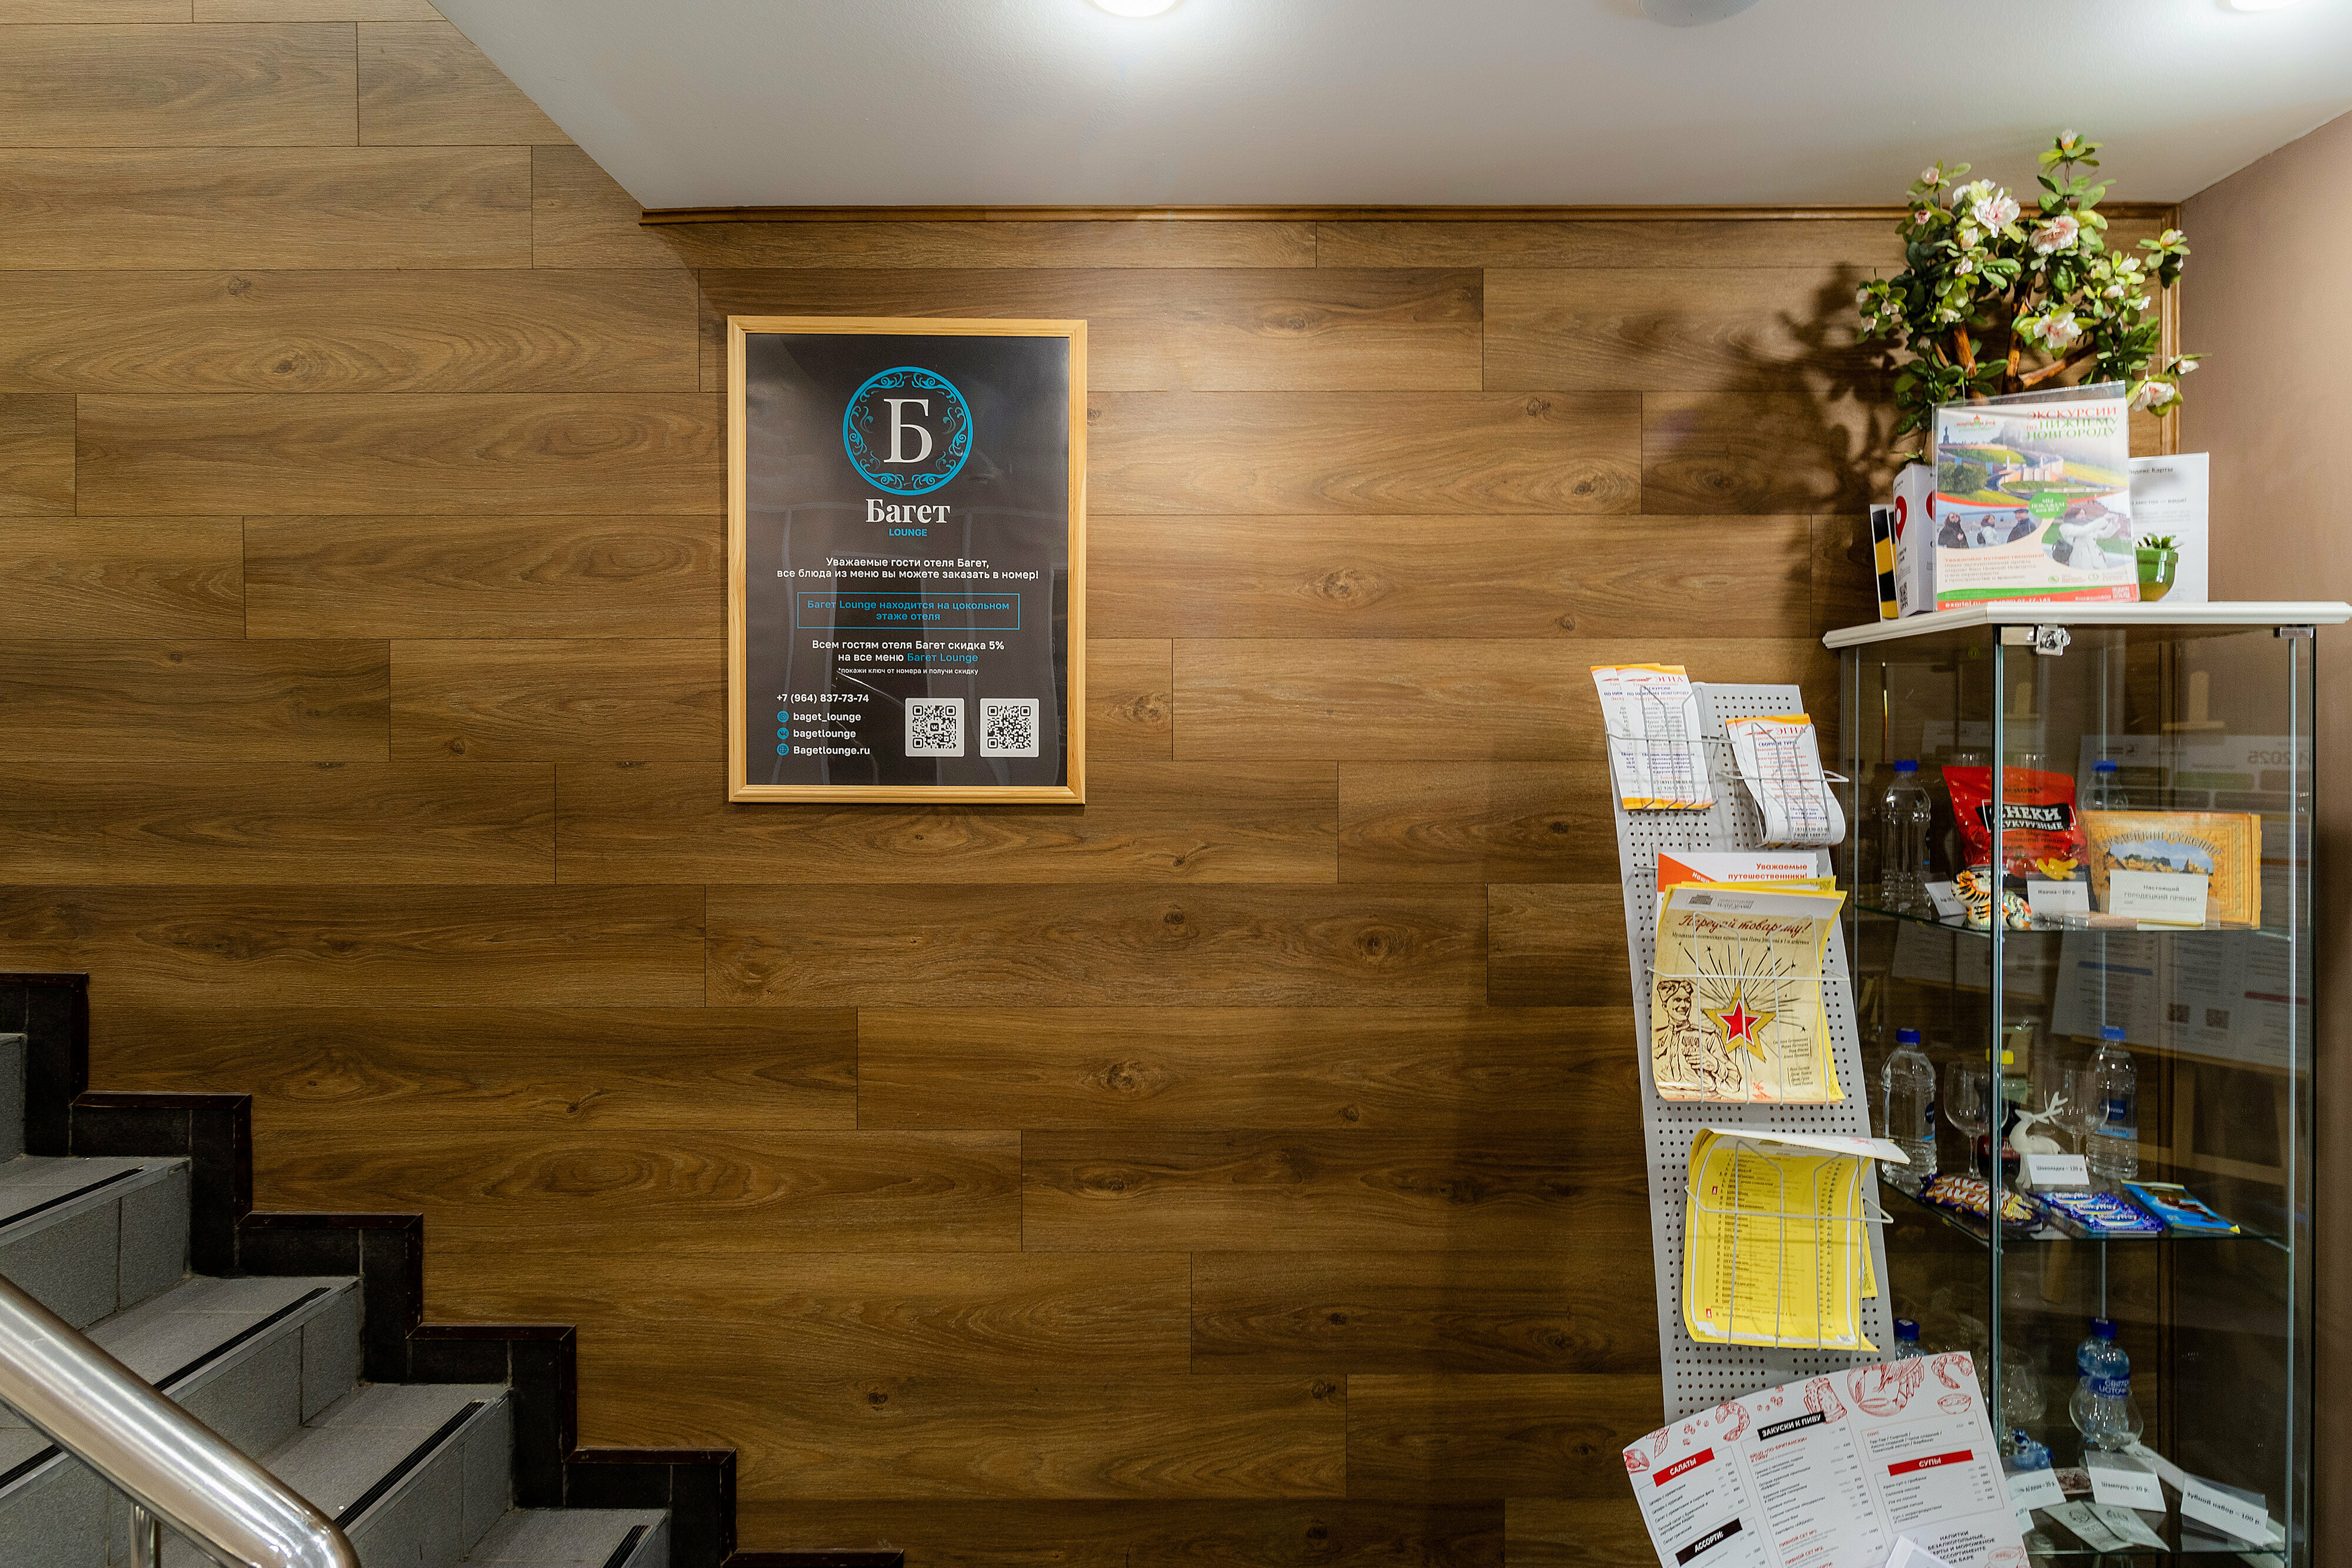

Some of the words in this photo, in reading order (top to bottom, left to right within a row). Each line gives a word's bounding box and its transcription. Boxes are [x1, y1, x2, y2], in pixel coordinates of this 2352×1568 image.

[2027, 407, 2117, 420] ЭКСКУРСИИ
[2039, 416, 2118, 429] НИЖНЕМУ
[883, 399, 933, 463] Б
[2027, 427, 2117, 440] НОВГОРОДУ
[866, 499, 951, 523] Багет
[889, 529, 927, 537] LOUNGE
[826, 557, 888, 568] Уважаемые
[924, 559, 954, 567] отеля
[957, 559, 990, 569] Багет,
[798, 569, 831, 579] блюда
[834, 570, 847, 578] из
[898, 570, 940, 579] можете
[942, 571, 990, 579] заказать
[1001, 570, 1039, 581] номер!
[807, 600, 837, 609] Багет
[839, 600, 876, 610] Lounge
[880, 602, 934, 610] находится
[953, 601, 1010, 610] цокольном
[876, 613, 907, 621] этаже
[910, 613, 940, 621] отеля
[812, 640, 839, 649] Всем
[842, 641, 879, 650] гостям
[882, 641, 912, 650] отеля
[915, 640, 945, 650] Багет
[948, 641, 985, 651] скидка
[988, 641, 1004, 650] 5%
[876, 654, 904, 662] меню
[907, 653, 937, 662] Багет
[940, 653, 978, 663] Lounge
[790, 693, 817, 704] (964)
[820, 694, 869, 703] 837-73-74
[793, 712, 861, 722] baget_lounge
[793, 729, 856, 738] bagetlounge
[793, 745, 870, 756] Bagetlounge.ru
[2124, 892, 2168, 901] ГОРОДЕЦКИЙ
[1762, 1421, 1794, 1437] ЗАКУСКИ
[1795, 1419, 1801, 1427] К
[1802, 1414, 1821, 1426] ПИВУ
[1670, 1457, 1697, 1476] САЛАТЫ
[1919, 1457, 1941, 1467] СУПЫ
[2187, 1492, 2211, 1505] Зубной
[2213, 1502, 2234, 1514] набор
[2241, 1513, 2254, 1522] 100
[1940, 1530, 1969, 1540] НАПИТКИ
[1927, 1533, 1986, 1551] БЕЗАЛКОГОЛЬНЫЕ,
[1933, 1547, 1949, 1556] ЕРТЫ
[1956, 1538, 1995, 1551] МОРОЖЕНОЕ
